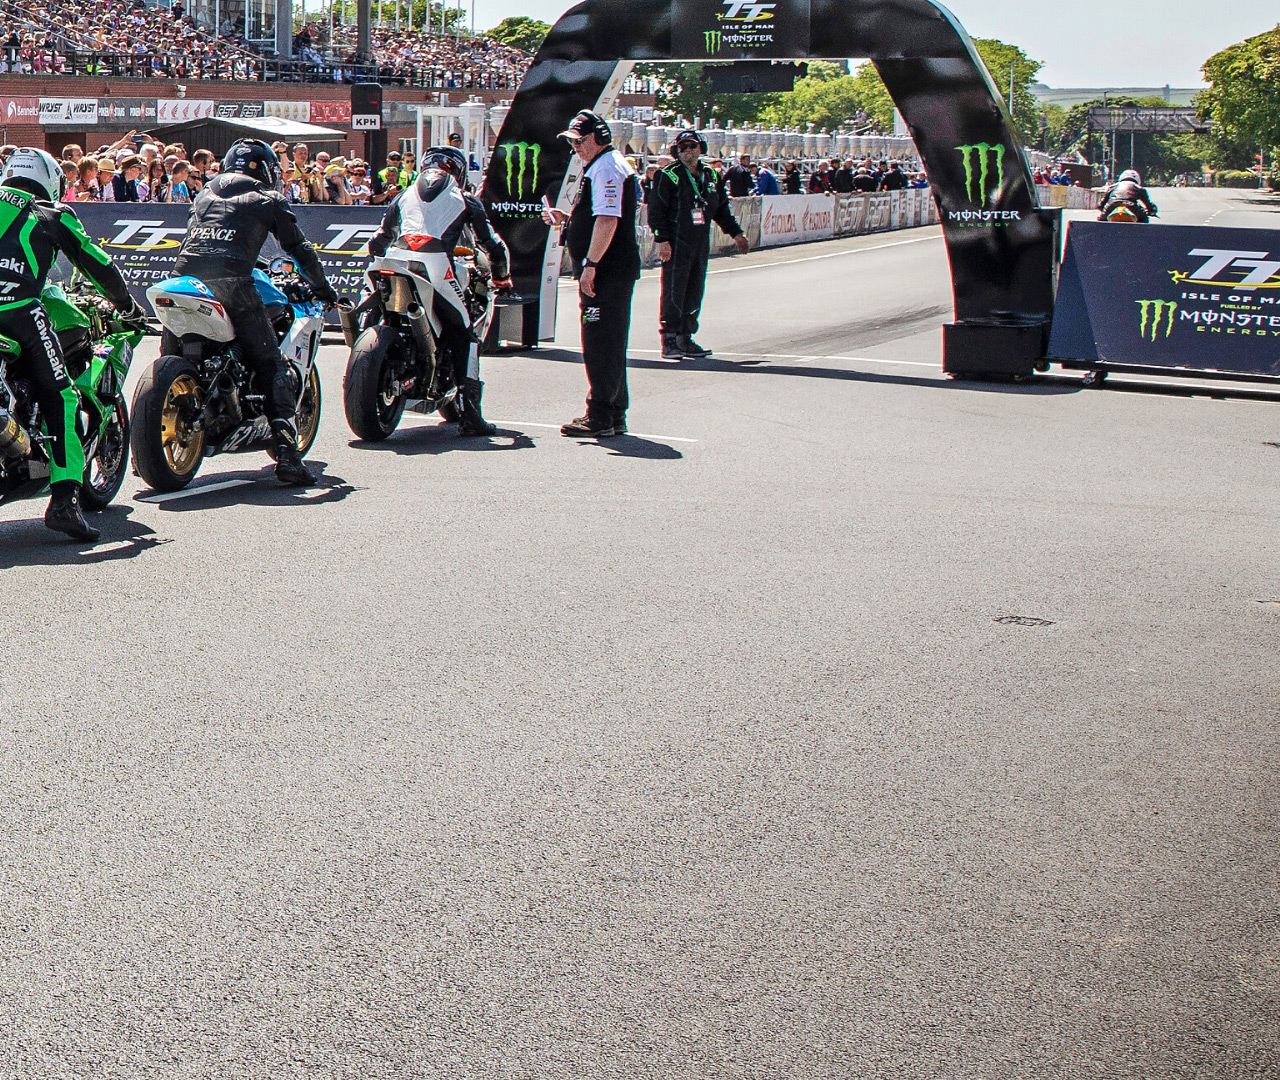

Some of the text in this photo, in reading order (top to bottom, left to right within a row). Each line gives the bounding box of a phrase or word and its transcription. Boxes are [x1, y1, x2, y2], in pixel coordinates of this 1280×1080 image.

[722, 34, 774, 43] MONSTER
[17, 105, 39, 116] Bennetts
[40, 102, 63, 113] WRYST
[73, 103, 96, 114] WRYST
[216, 104, 239, 117] RST
[241, 104, 262, 117] RST
[355, 118, 377, 126] KPH
[491, 201, 544, 214] MONSTE
[948, 209, 1021, 222] MONSTER
[770, 214, 798, 235] HONDA
[112, 219, 188, 252] TT
[190, 227, 237, 242] SPENCE
[130, 254, 146, 262] OF
[321, 260, 364, 268] SLE OF
[1181, 292, 1253, 303] ISLE OF
[1180, 309, 1280, 327] MONSTE
[29, 305, 67, 382] Kawasaki
